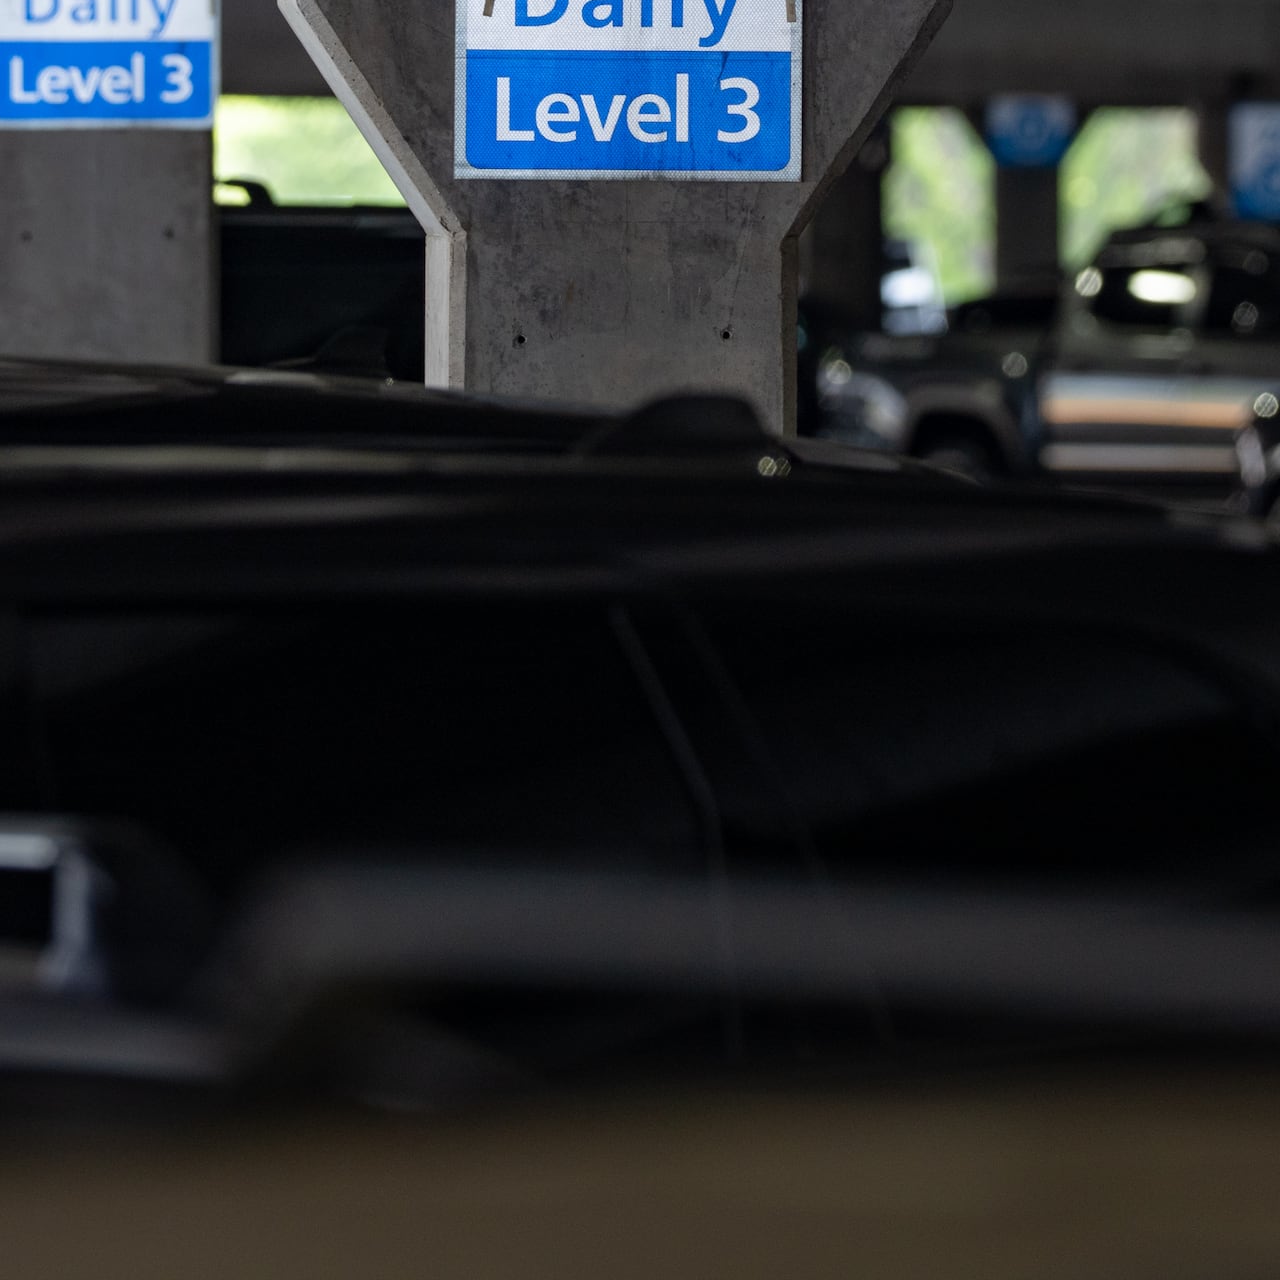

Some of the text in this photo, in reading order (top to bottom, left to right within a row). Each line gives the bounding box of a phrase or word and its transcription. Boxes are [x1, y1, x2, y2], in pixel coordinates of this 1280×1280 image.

[8, 51, 194, 105] Level 3
[496, 73, 761, 144] Level 3
